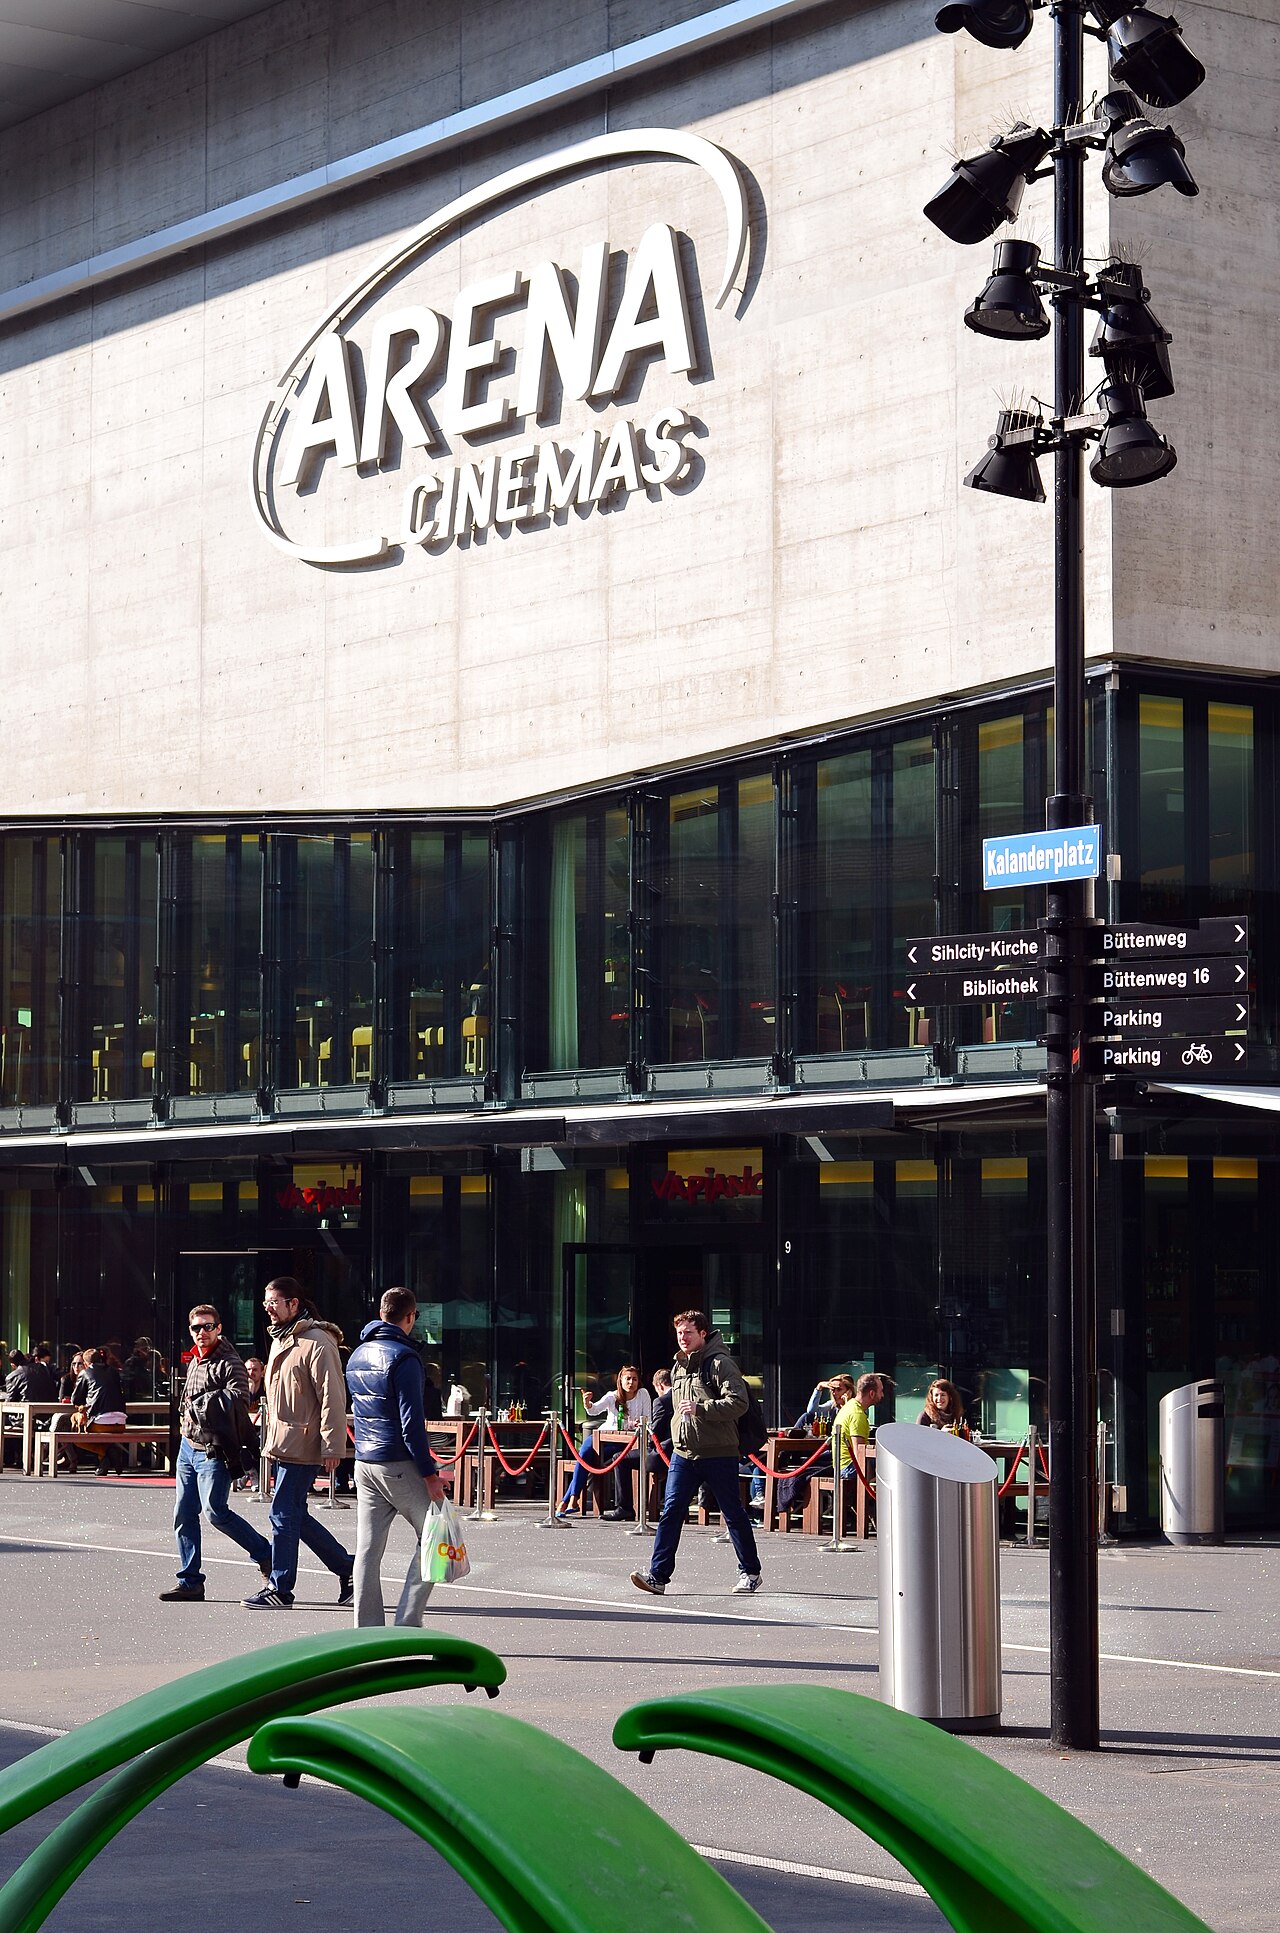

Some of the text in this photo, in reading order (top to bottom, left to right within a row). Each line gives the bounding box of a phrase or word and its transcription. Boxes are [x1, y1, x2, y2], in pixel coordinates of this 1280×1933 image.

[280, 222, 697, 486] ARENA
[400, 407, 689, 545] CINEMAS
[987, 841, 1094, 876] Kalanderplatz
[1103, 931, 1187, 950] Büttenweg
[931, 940, 1039, 963] Sihlcity-Kirche
[963, 976, 1039, 997] Bibliothek
[1103, 968, 1210, 989] Büttenweg 16
[1103, 1009, 1162, 1028] Parking
[1103, 1047, 1161, 1067] Parking
[784, 1241, 792, 1254] 9
